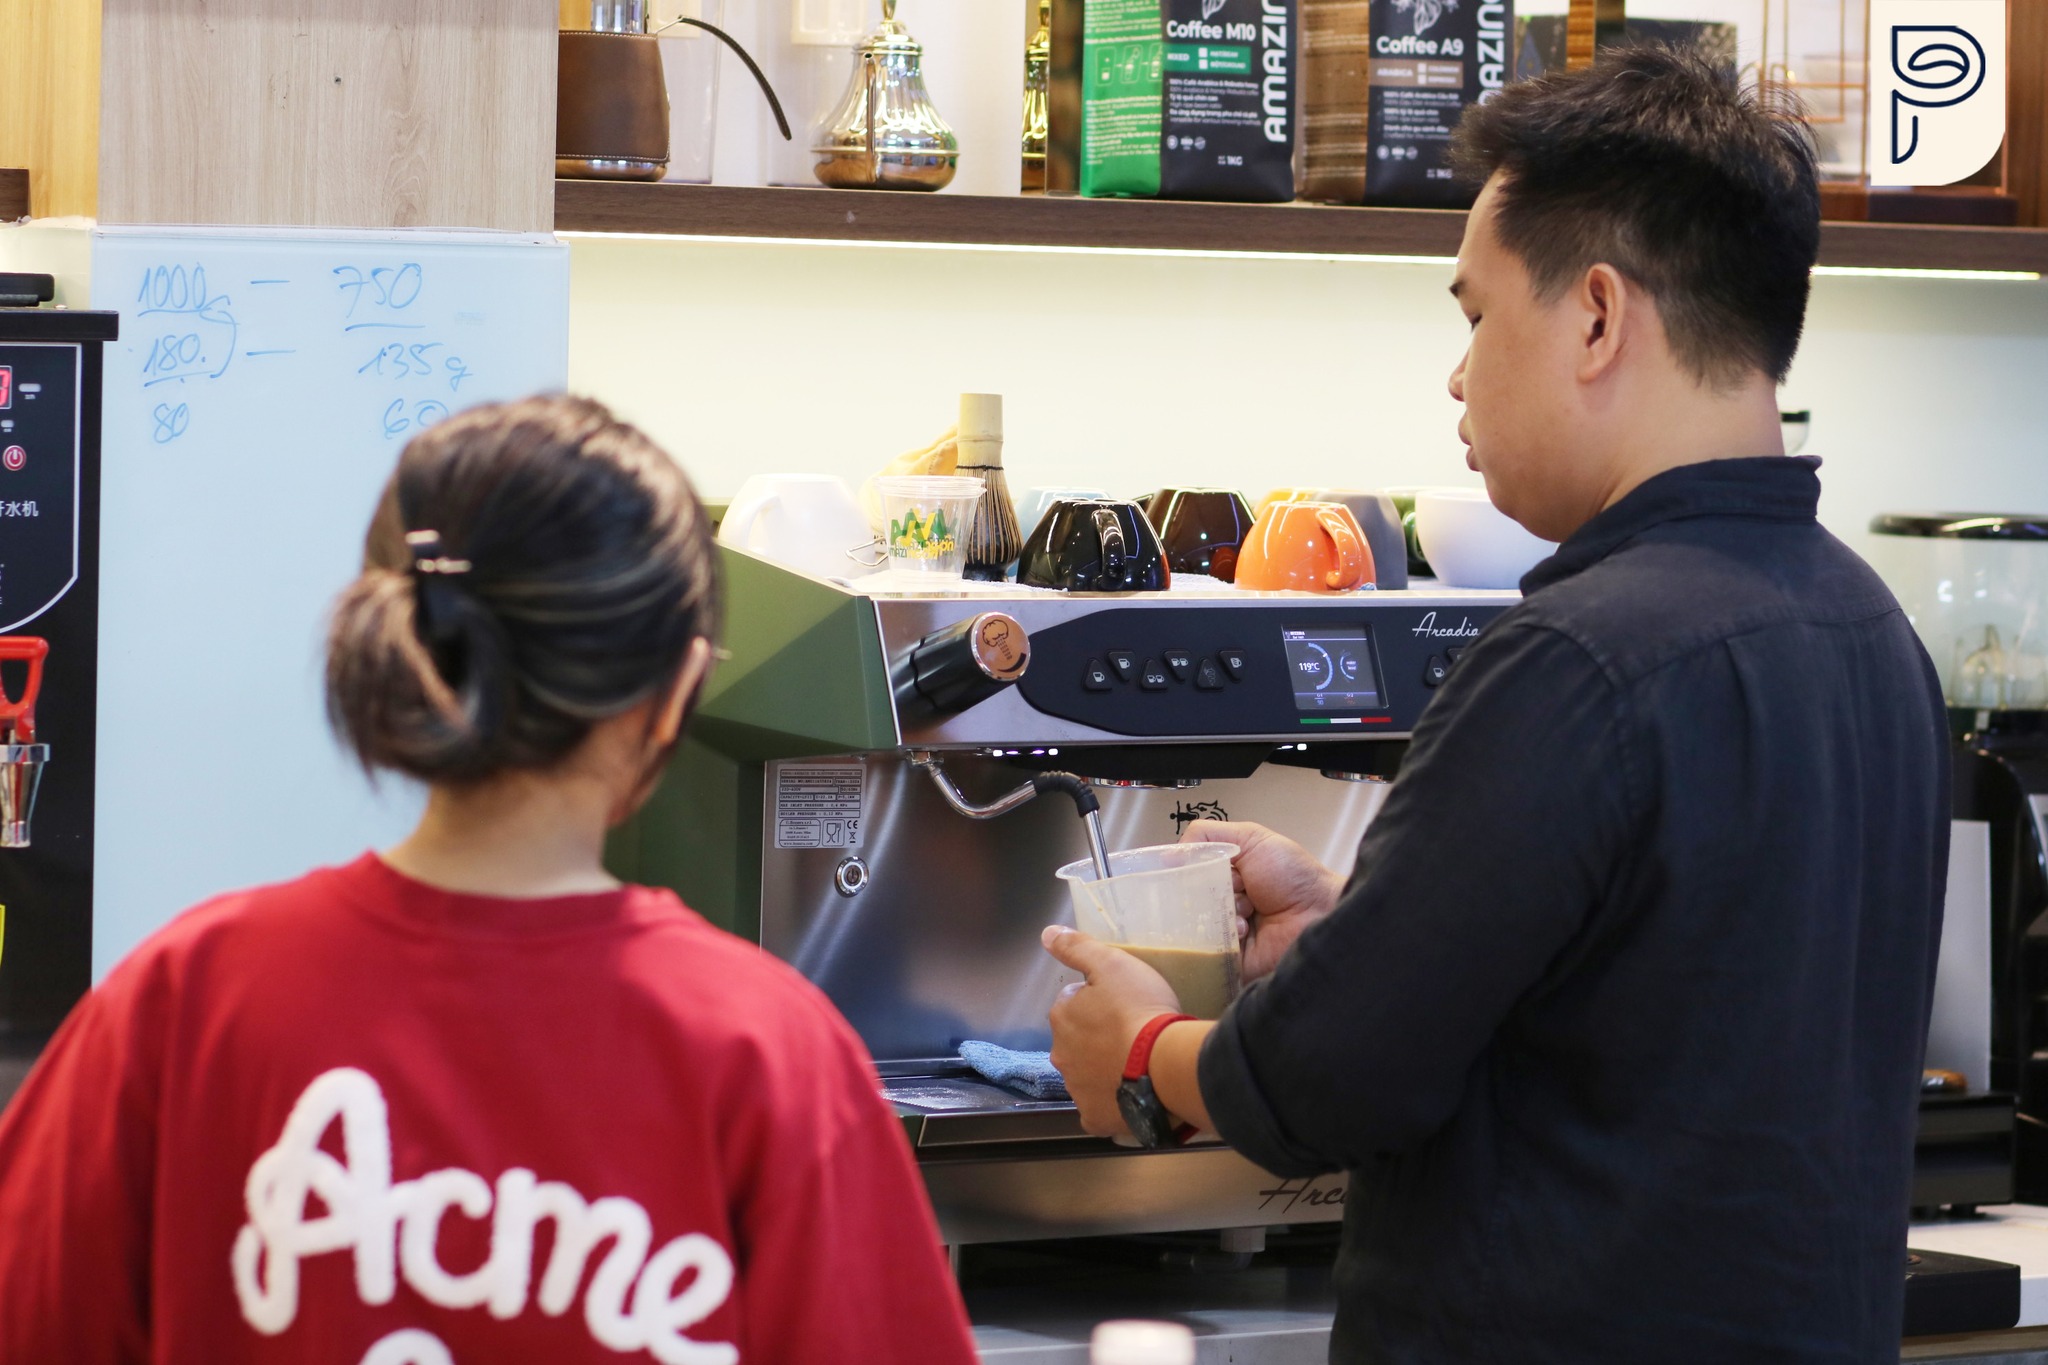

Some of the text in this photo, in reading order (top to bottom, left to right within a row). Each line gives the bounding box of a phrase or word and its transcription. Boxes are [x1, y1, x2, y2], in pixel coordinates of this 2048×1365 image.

[1166, 20, 1256, 41] Coffee M10
[1376, 36, 1464, 56] Coffee A9
[333, 262, 423, 319] 750
[154, 402, 190, 444] 80
[0, 501, 39, 517] 水机
[1412, 612, 1479, 638] Arcadia
[846, 820, 858, 829] CE
